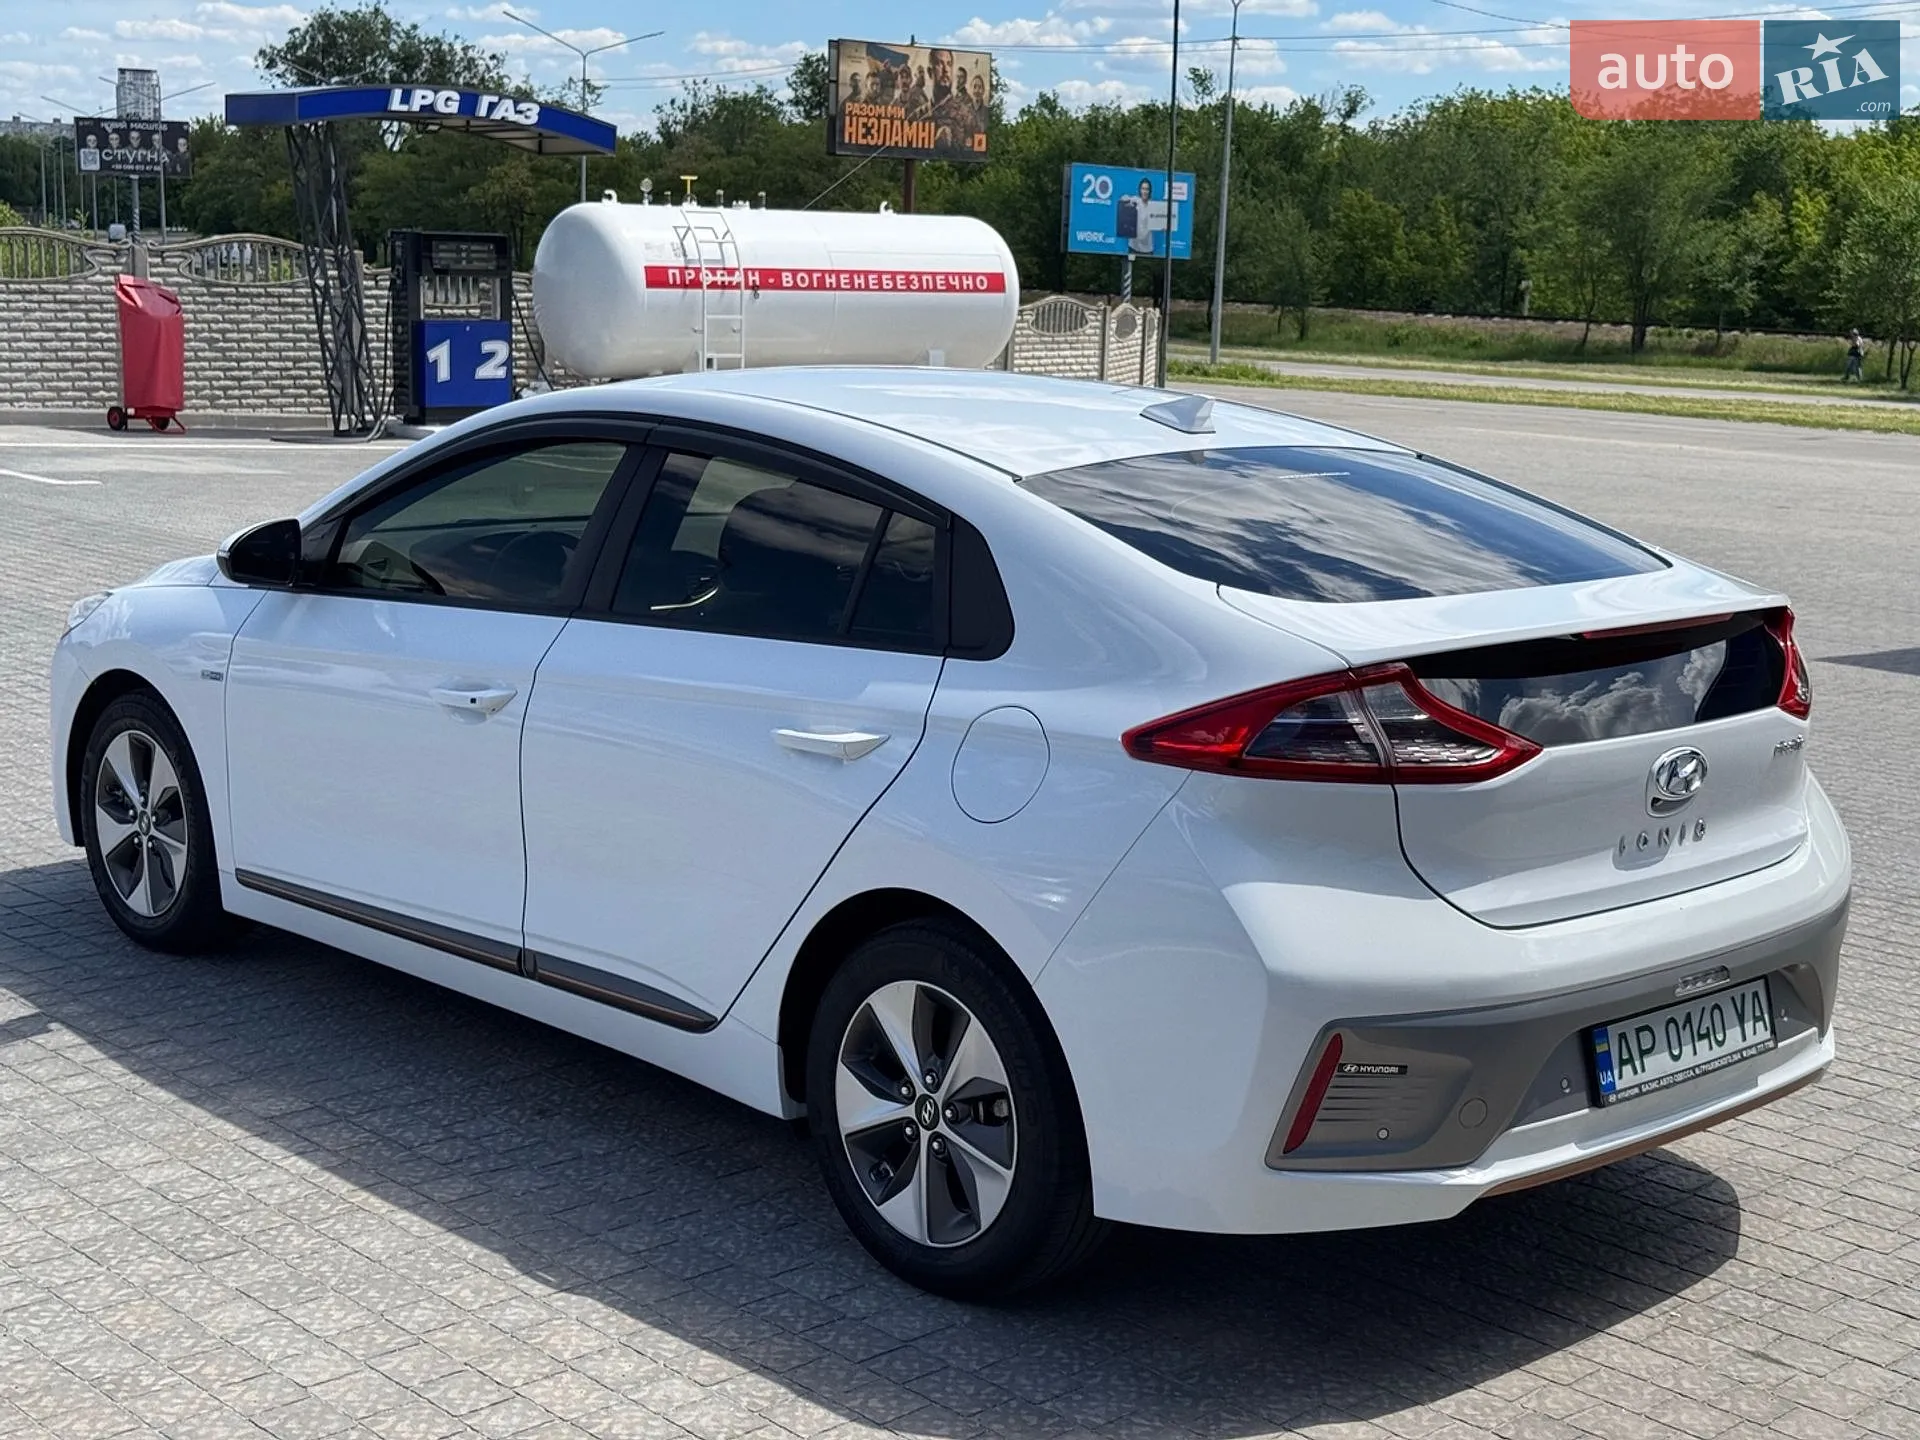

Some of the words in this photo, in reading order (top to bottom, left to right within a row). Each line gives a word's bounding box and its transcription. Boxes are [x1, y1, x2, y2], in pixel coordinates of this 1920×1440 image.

[388, 88, 460, 114] LPG
[475, 94, 540, 125] ГАЗ
[845, 102, 885, 117] РАЗОМ
[844, 116, 935, 149] НЕЗЛАМНІ
[1082, 174, 1113, 200] 20
[781, 272, 988, 290] ВОГНЕНЕБЕЗПЕЧНО
[426, 338, 450, 383] 1
[474, 340, 509, 380] 2
[1618, 1024, 1656, 1080] AP
[1665, 1003, 1726, 1062] 0140
[1731, 990, 1768, 1042] YA
[1359, 1065, 1398, 1074] HYUNDAI
[1600, 1070, 1613, 1085] UA
